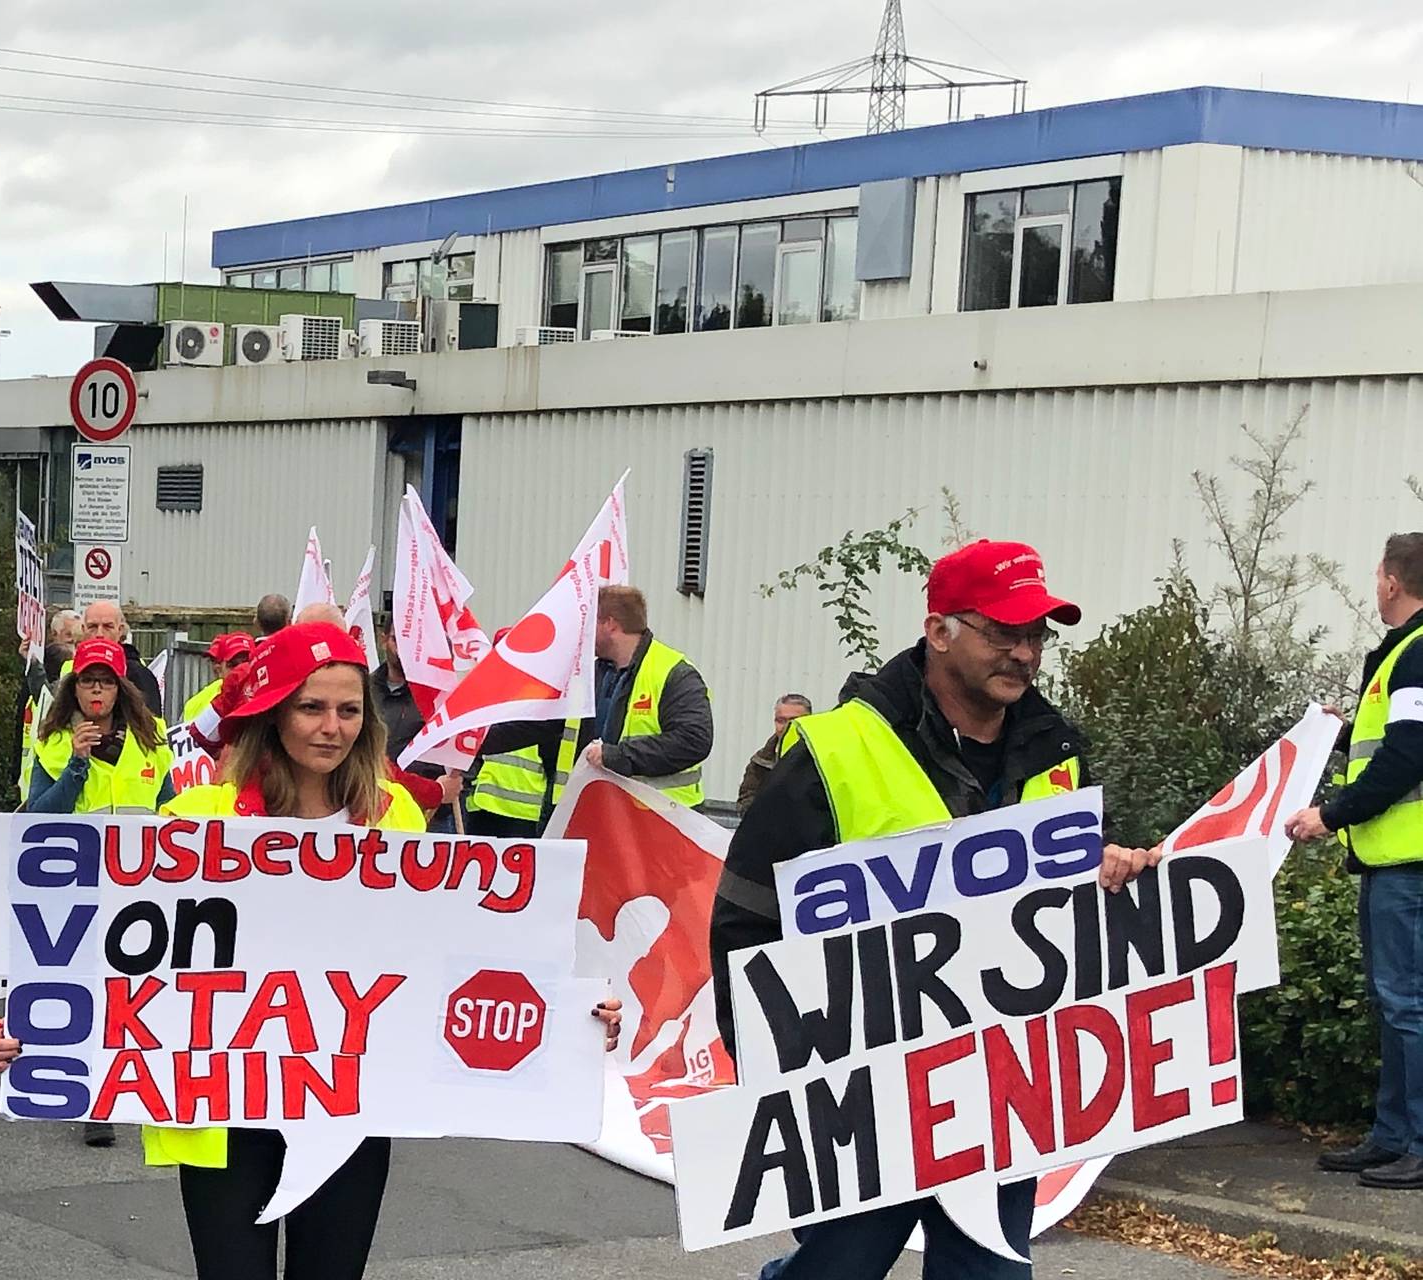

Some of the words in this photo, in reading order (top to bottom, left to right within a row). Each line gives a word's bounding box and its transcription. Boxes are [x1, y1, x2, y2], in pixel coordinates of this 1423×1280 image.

[88, 382, 120, 419] 10
[794, 811, 1102, 936] avos
[12, 897, 238, 976] von
[743, 913, 973, 1074] WIR
[980, 856, 1245, 1018] SIND
[451, 996, 539, 1043] STOP
[723, 1064, 883, 1232] AM
[905, 961, 1239, 1192] ENDE!
